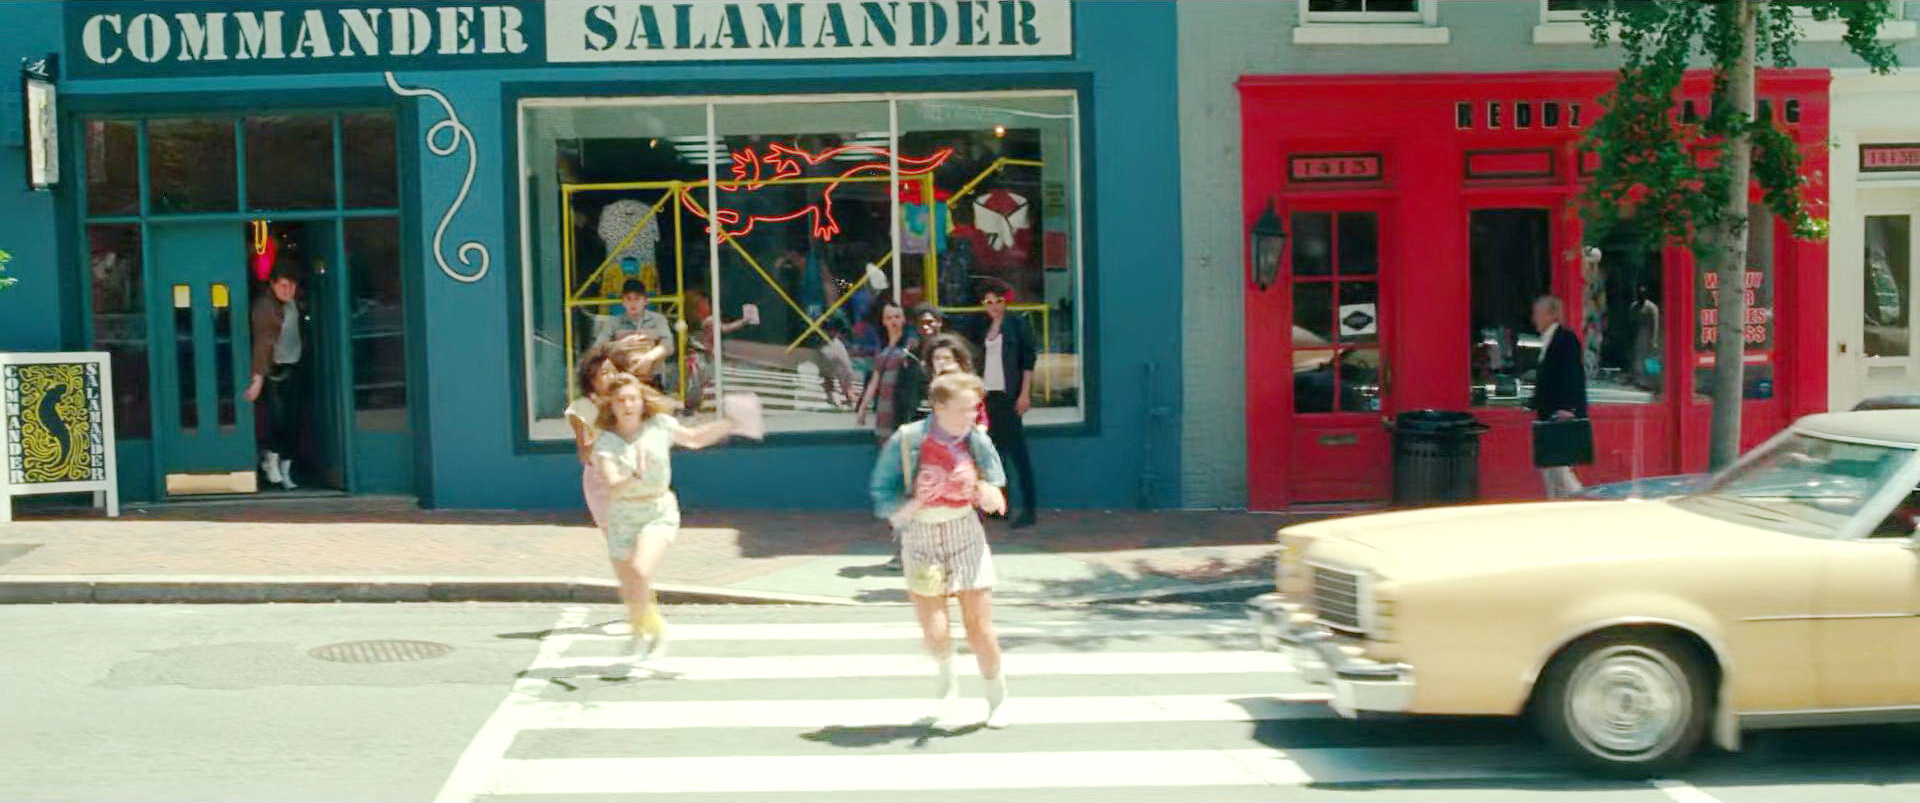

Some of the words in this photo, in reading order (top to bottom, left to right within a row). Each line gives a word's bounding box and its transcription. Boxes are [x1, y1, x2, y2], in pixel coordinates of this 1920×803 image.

[82, 5, 529, 63] COMMANDER
[582, 0, 1042, 52] SALAMANDER
[5, 366, 25, 484] COMMANDER
[86, 362, 105, 480] SALAMANDER
